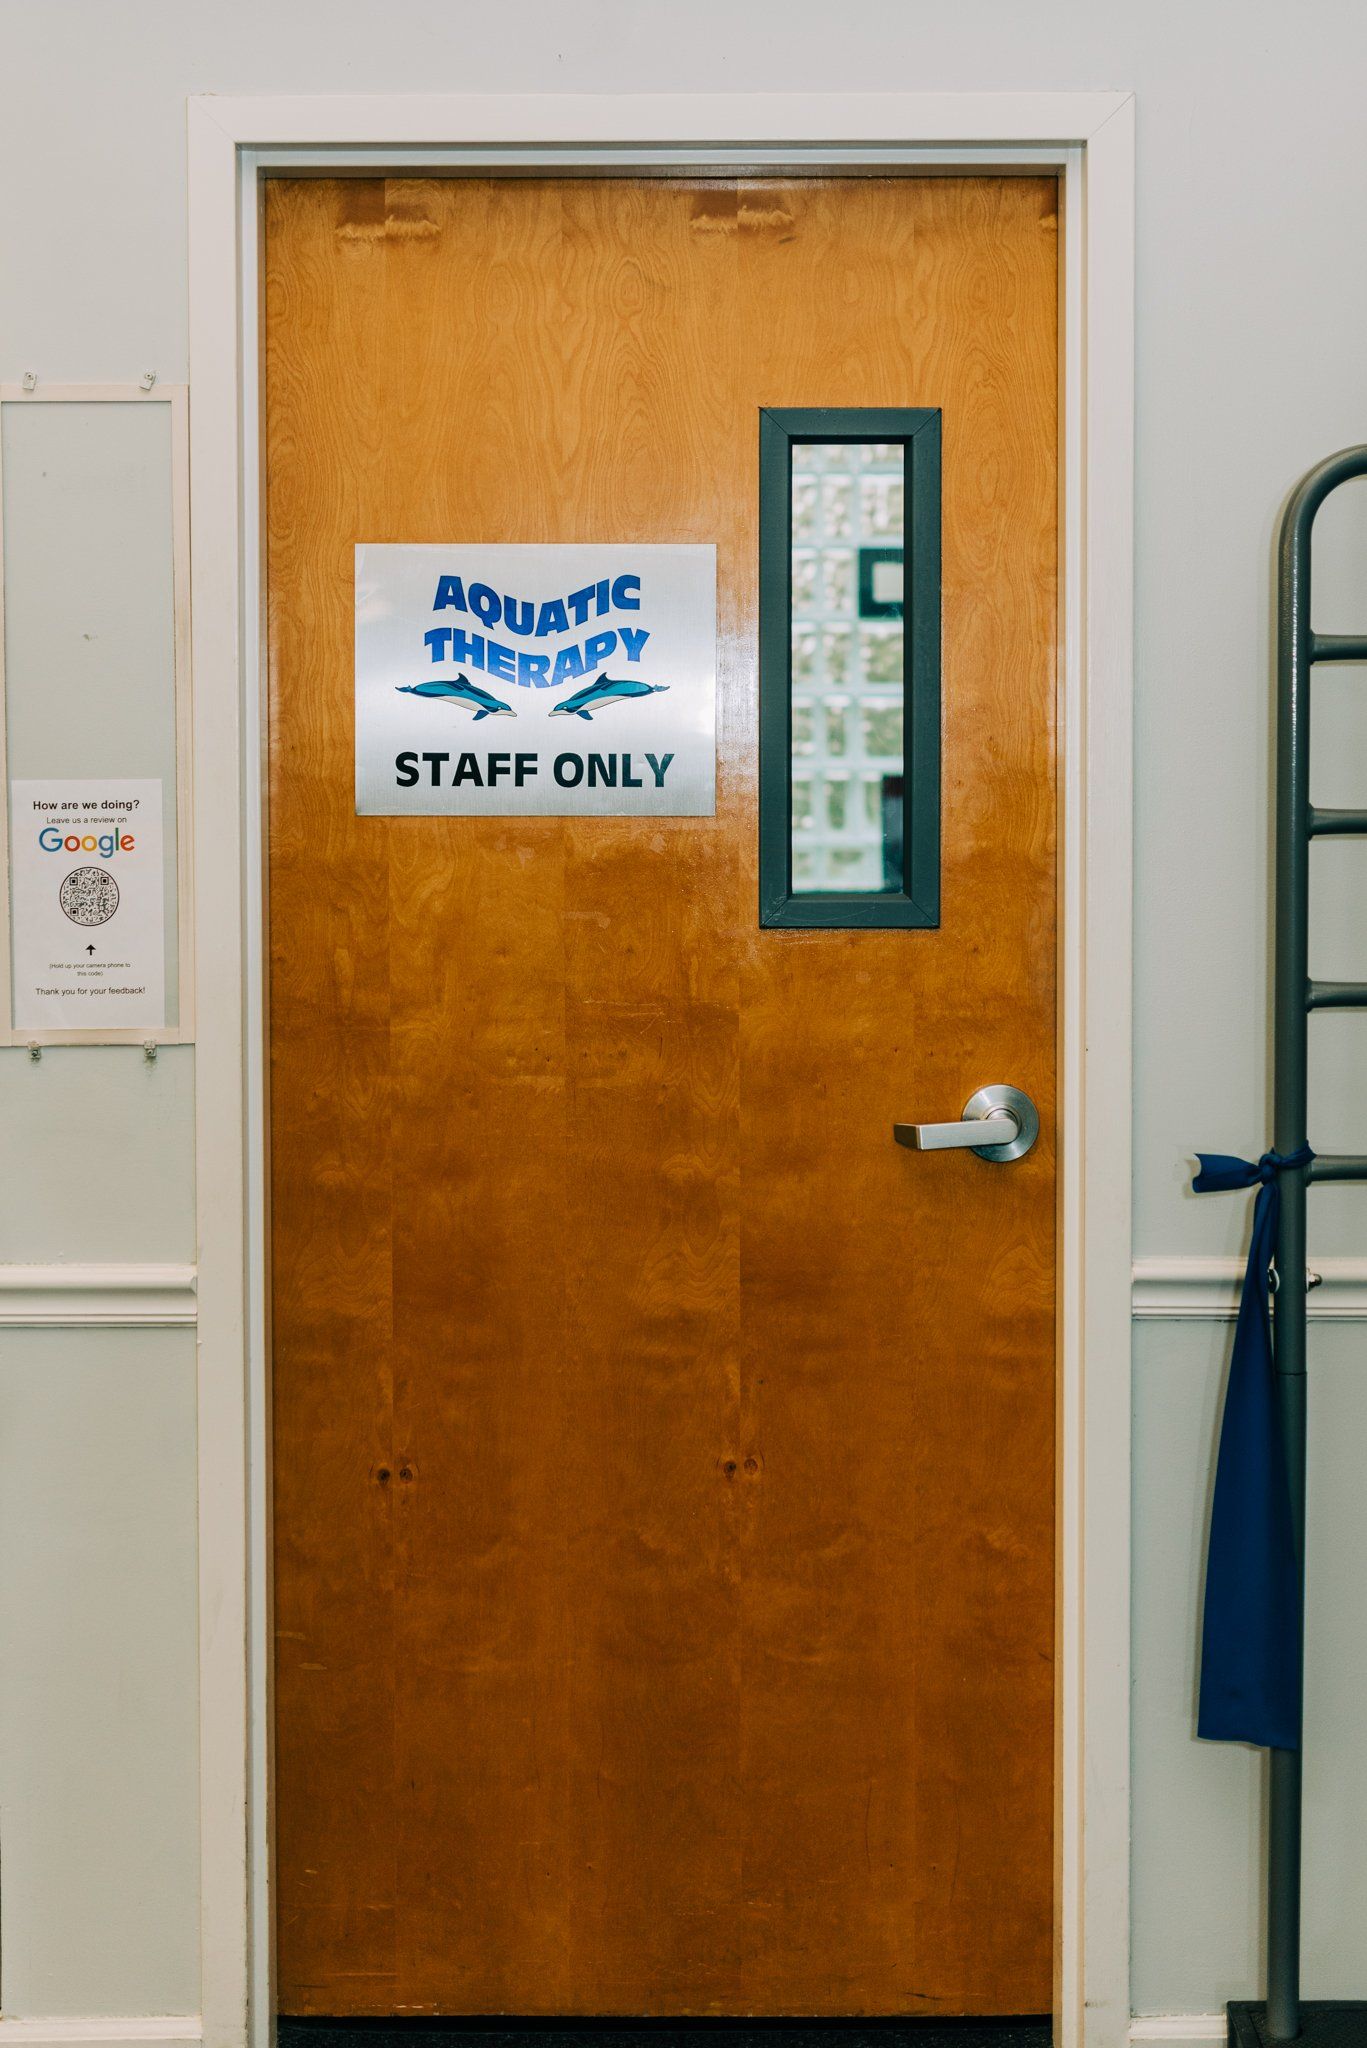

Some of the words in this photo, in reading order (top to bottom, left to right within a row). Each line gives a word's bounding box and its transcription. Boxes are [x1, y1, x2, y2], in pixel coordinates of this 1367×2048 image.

[432, 574, 641, 637] AQUATIC
[424, 627, 651, 689] THERAPY
[395, 751, 538, 788] STAFF
[553, 752, 675, 788] ONLY
[33, 800, 58, 810] How
[61, 802, 79, 810] are
[82, 802, 98, 810] we
[101, 799, 140, 811] doing?
[39, 827, 135, 859] Google
[36, 987, 60, 995] Thank
[61, 988, 75, 996] you
[77, 987, 87, 995] for
[89, 987, 107, 996] your
[108, 986, 146, 995] feedback!
